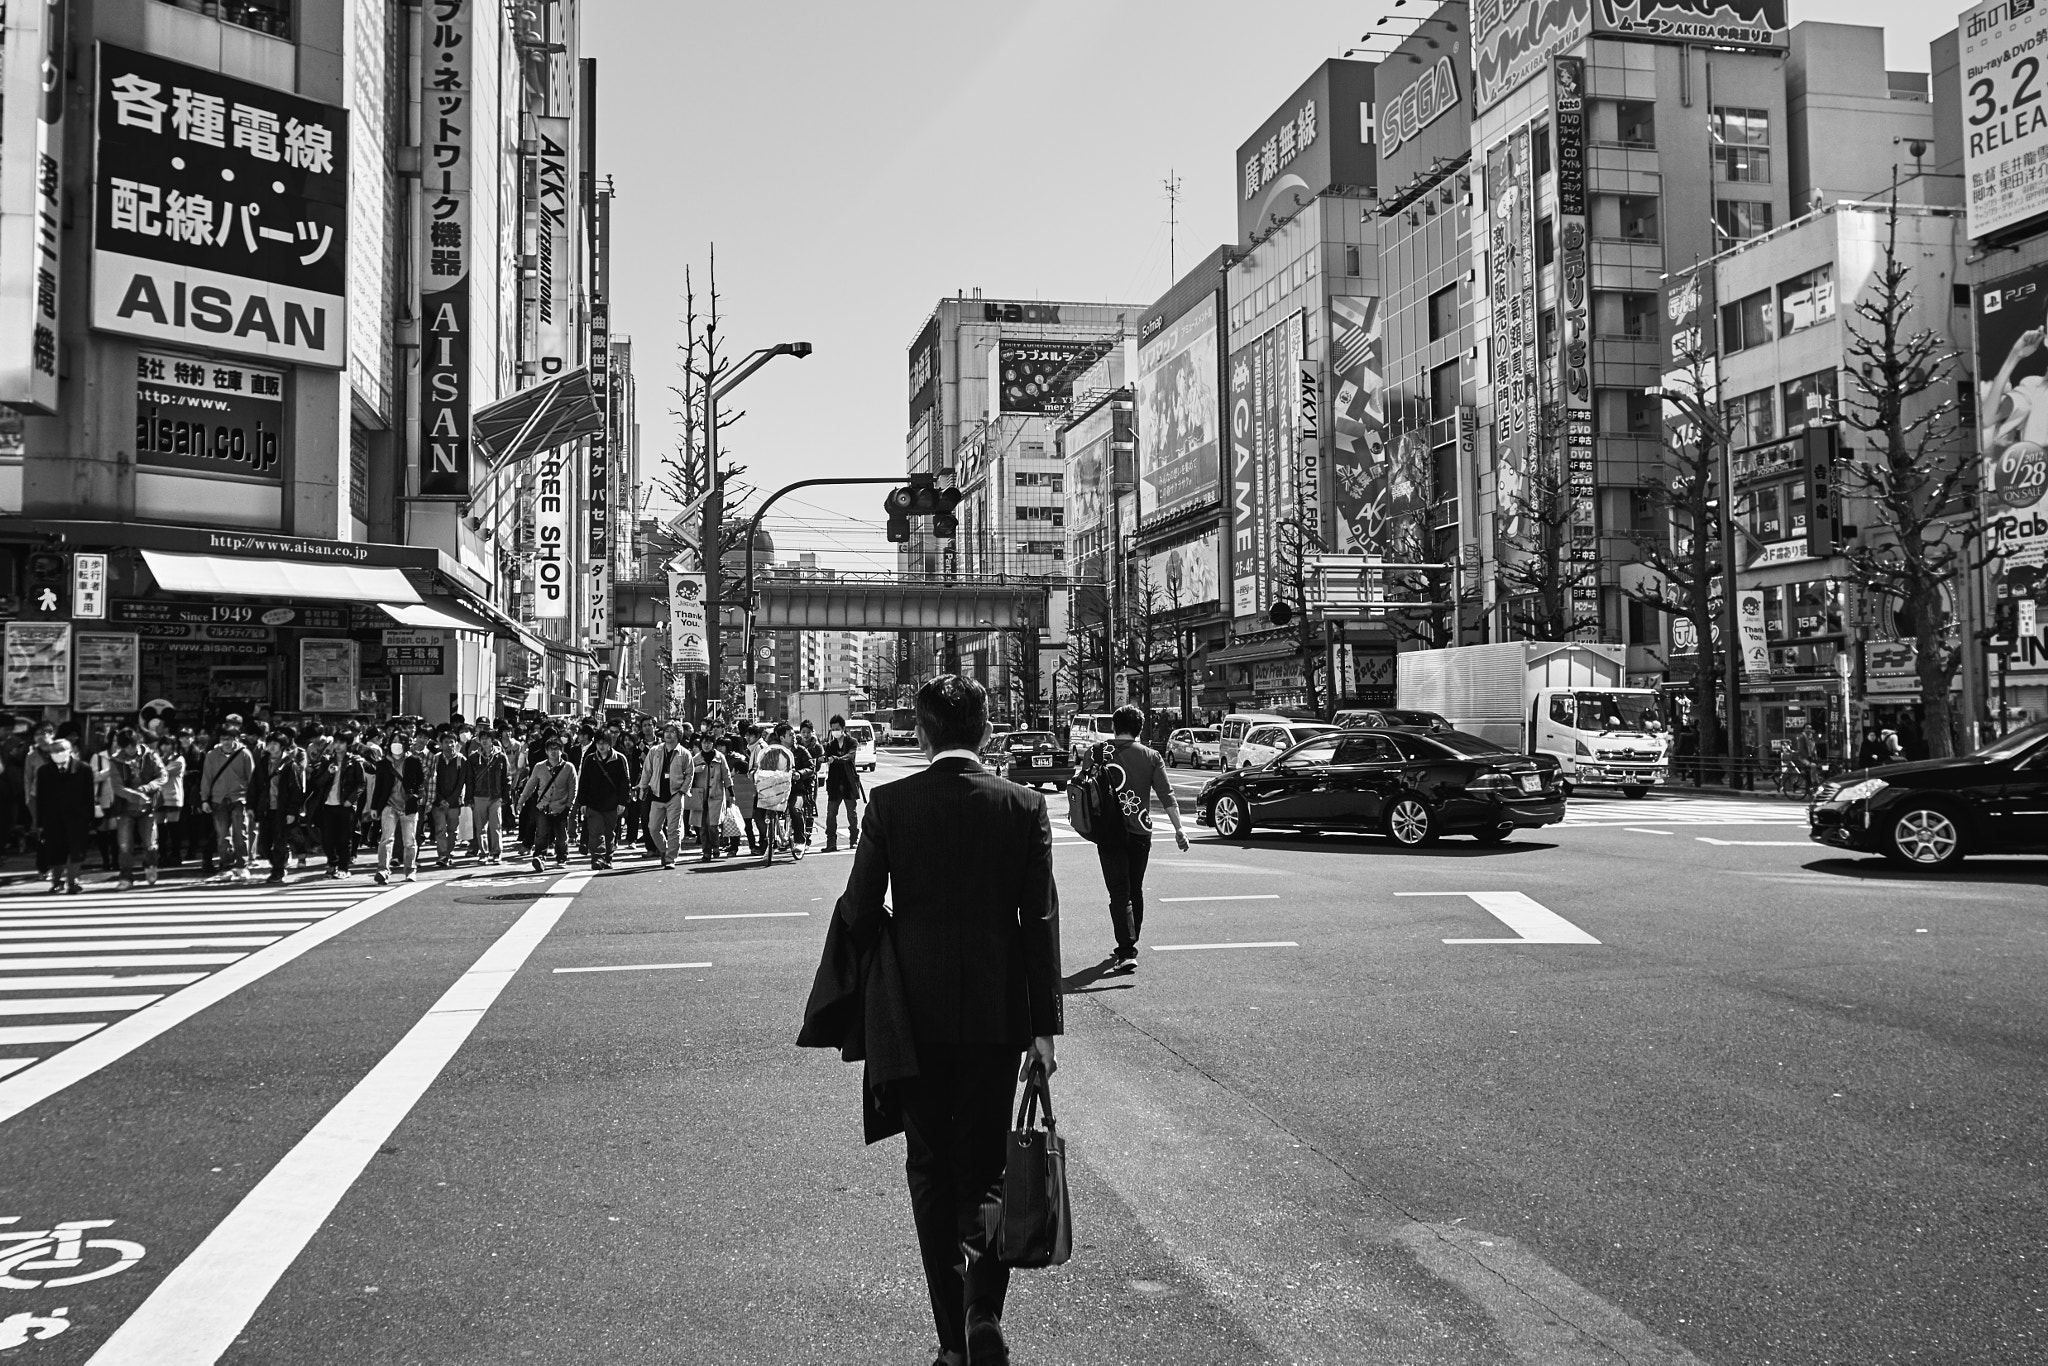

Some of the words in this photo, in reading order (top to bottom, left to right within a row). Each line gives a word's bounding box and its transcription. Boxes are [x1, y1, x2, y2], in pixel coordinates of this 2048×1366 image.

[1619, 15, 1674, 34] ムーラン
[1675, 23, 1715, 39] AKIBA
[1968, 56, 2048, 126] 3.2
[1381, 54, 1461, 160] SEGA
[1560, 114, 1579, 124] DVD
[111, 73, 333, 174] 各種電線
[1561, 137, 1580, 147] ゲーム
[1564, 148, 1577, 158] CD
[540, 133, 566, 229] AKKY
[1561, 171, 1581, 180] アニメ
[111, 176, 333, 266] 配線パーツ
[540, 202, 552, 326] INTERNATIONAL
[2005, 283, 2036, 300] PS3
[116, 273, 325, 351] AISAN
[1142, 315, 1163, 339] Sofmap
[1140, 327, 1179, 372] ソフマップ
[174, 362, 205, 386] 特約
[213, 368, 242, 392] 在庫
[251, 373, 280, 396] 直販
[430, 302, 458, 475] AISAN
[1254, 355, 1263, 417] WELCOME!
[1302, 368, 1317, 427] AKKY
[1255, 421, 1263, 462] LATEST
[1462, 412, 1474, 453] GAME
[1569, 436, 1592, 446] 5F中古
[1570, 450, 1592, 459] DVD
[1570, 461, 1593, 471] 4F中古
[2002, 448, 2047, 489] 6/28
[1233, 398, 1252, 553] GAME
[1256, 464, 1264, 505] GAMES
[1305, 455, 1318, 501] DUTY
[2004, 491, 2021, 501] ON
[2021, 486, 2042, 499] SALE
[591, 488, 606, 541] パセラ
[1794, 514, 1806, 527] 13
[210, 534, 368, 559] http://www.aisan.co.jp
[540, 526, 562, 601] SHOP
[1235, 557, 1254, 577] 2F-4F
[1258, 560, 1266, 573] IN
[179, 611, 209, 622] Since
[210, 606, 252, 622] 1949
[591, 564, 605, 635] ダーツバー
[675, 610, 703, 621] Thank
[680, 619, 701, 628] You.
[1744, 626, 1764, 634] Thank
[1749, 633, 1763, 641] You.
[1370, 658, 1393, 685] SHOP
